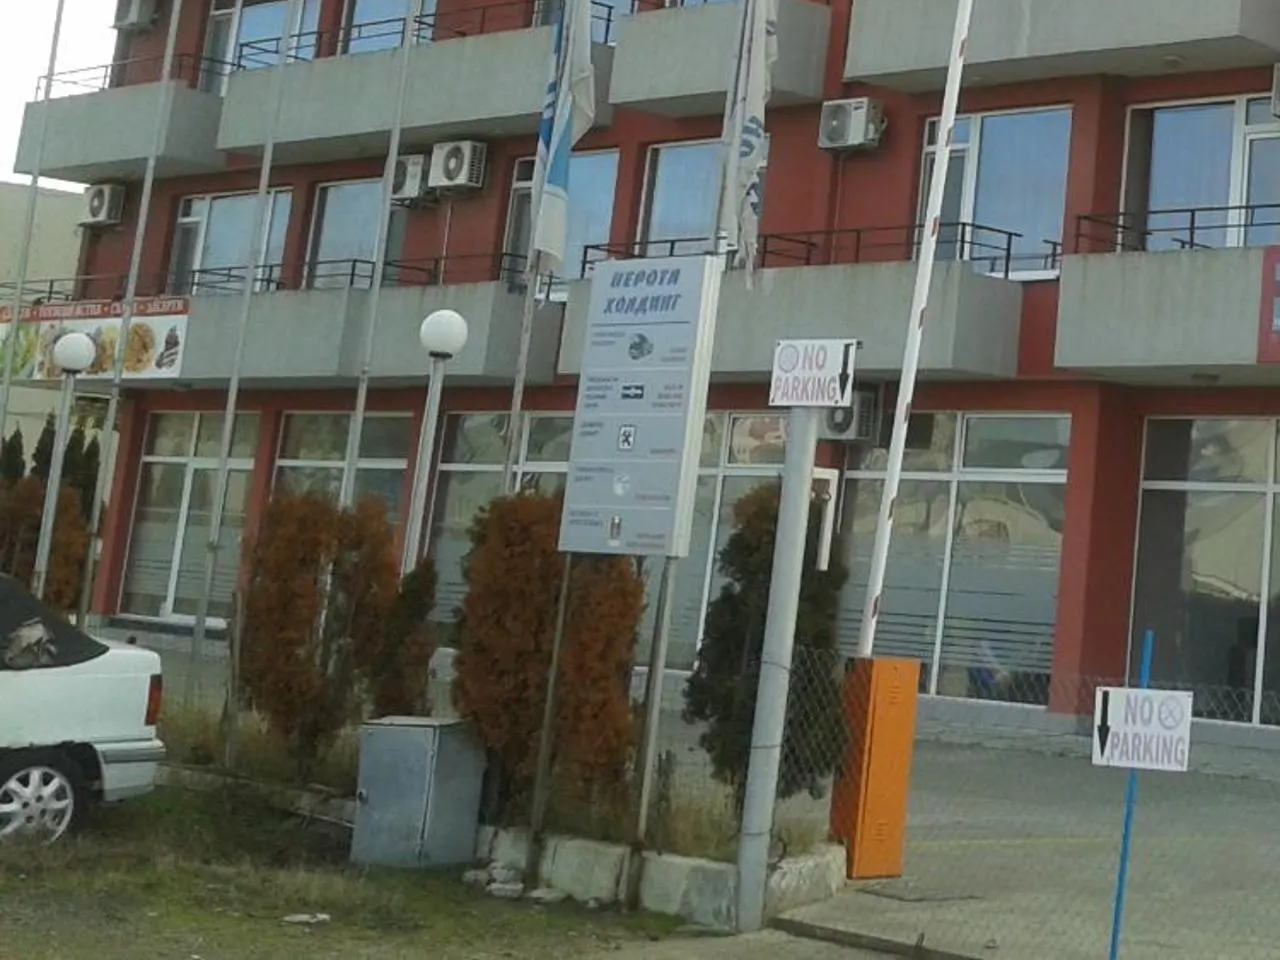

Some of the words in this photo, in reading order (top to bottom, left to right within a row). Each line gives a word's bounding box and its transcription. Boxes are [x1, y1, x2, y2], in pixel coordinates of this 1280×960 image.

[802, 344, 828, 371] NO
[773, 374, 838, 402] PARKING
[1124, 692, 1154, 727] NO
[1110, 730, 1186, 766] PARKING
